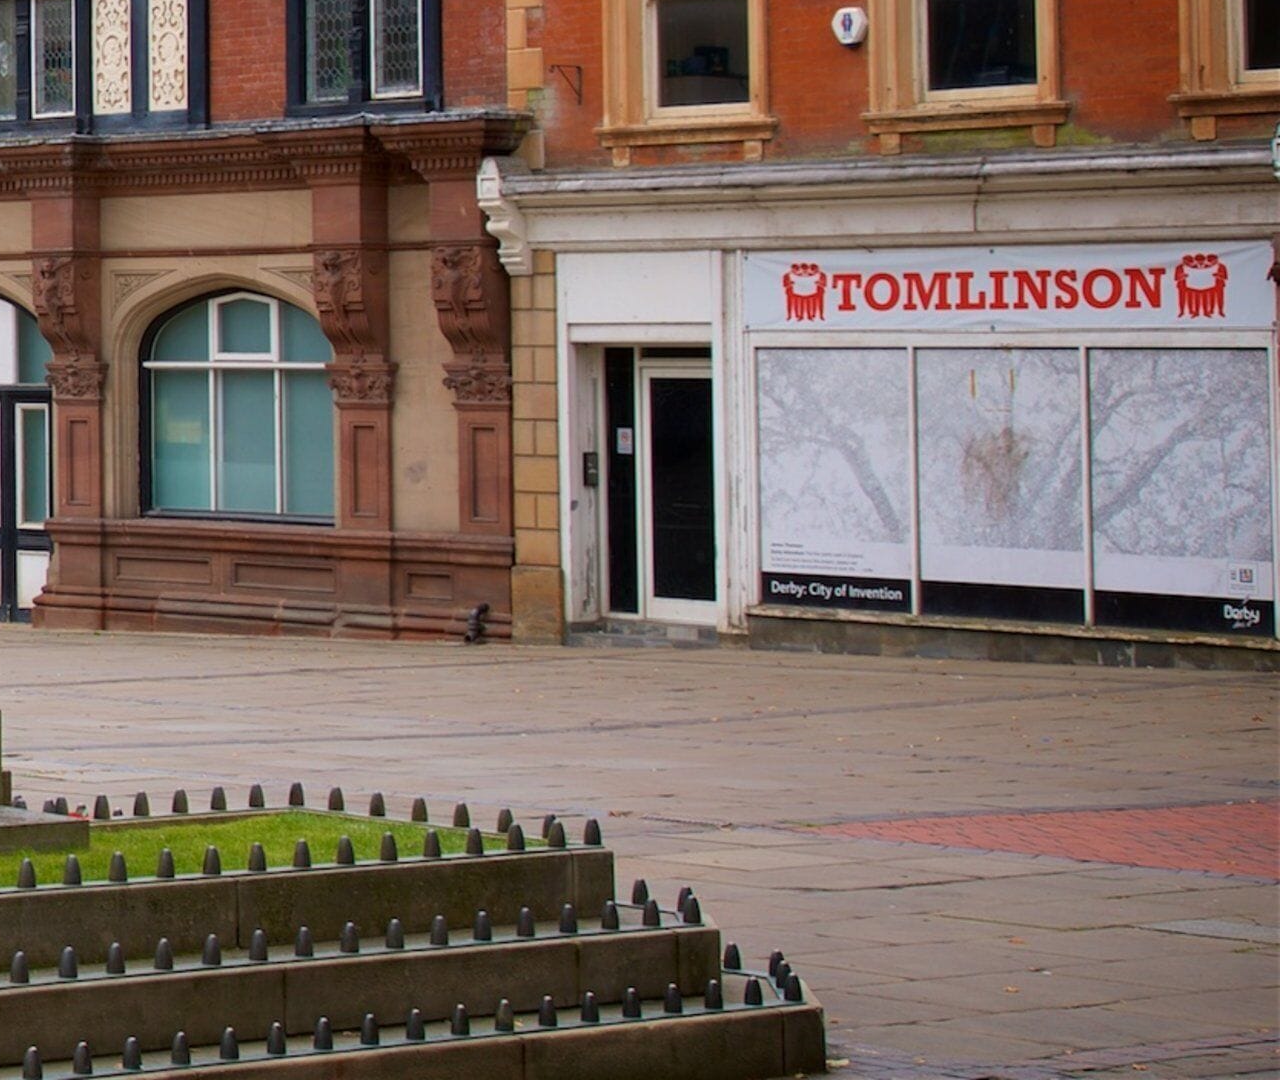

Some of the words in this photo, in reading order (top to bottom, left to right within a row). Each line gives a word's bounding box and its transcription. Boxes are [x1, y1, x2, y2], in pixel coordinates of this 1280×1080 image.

[832, 267, 1166, 311] TOMLINSON
[771, 580, 807, 598] Derby:
[809, 582, 832, 599] City
[834, 584, 847, 597] of
[848, 585, 903, 600] Invention
[1223, 604, 1260, 625] Derby
